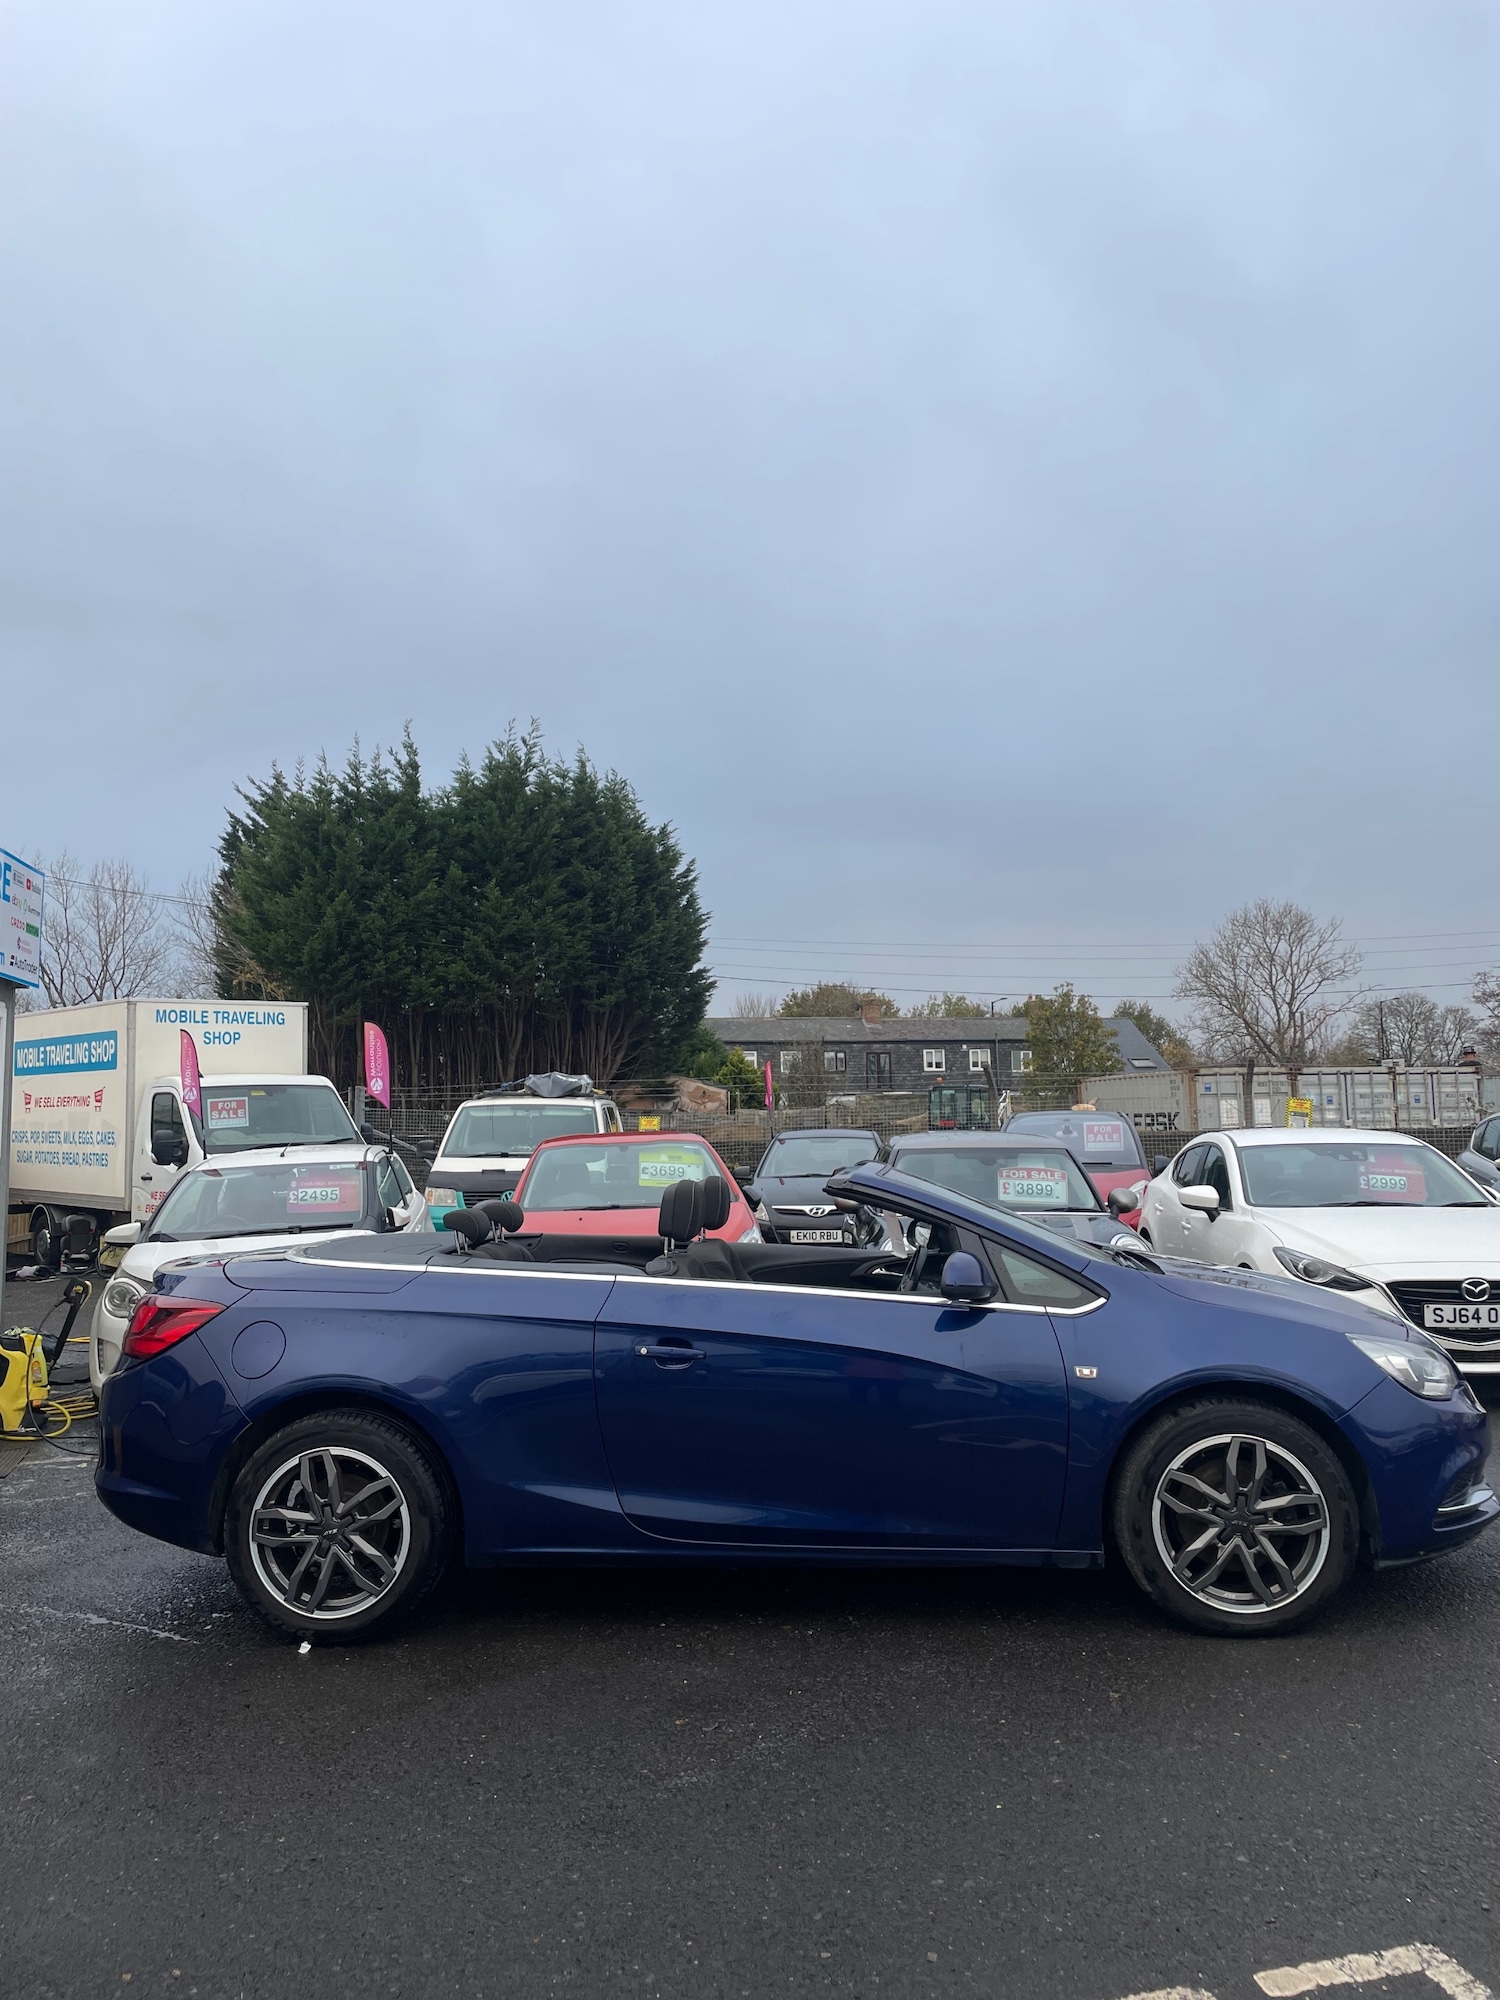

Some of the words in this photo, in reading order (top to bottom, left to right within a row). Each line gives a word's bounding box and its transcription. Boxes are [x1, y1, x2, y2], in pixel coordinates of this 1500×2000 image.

[156, 1009, 209, 1024] MOBILE
[213, 1011, 285, 1025] TRAVELING
[203, 1031, 241, 1045] SHOP
[17, 1047, 45, 1068] MOBILE
[46, 1042, 89, 1066] TRAVELING
[91, 1039, 115, 1063] SHOP
[35, 1097, 42, 1108] WE
[43, 1097, 55, 1108] SELL
[56, 1095, 91, 1107] EVERYTHING
[218, 1101, 237, 1110] FOR
[211, 1109, 245, 1119] SALE
[1093, 1125, 1112, 1133] FOR
[96, 1131, 116, 1148] CAKES,
[1087, 1133, 1120, 1142] SALE
[82, 1153, 108, 1167] PASTRIES
[1002, 1169, 1028, 1179] FOR
[1031, 1170, 1062, 1180] SALE
[151, 1191, 159, 1200] WE
[796, 1231, 817, 1241] EK10
[820, 1231, 838, 1241] RBU
[1433, 1307, 1482, 1324] SJ64
